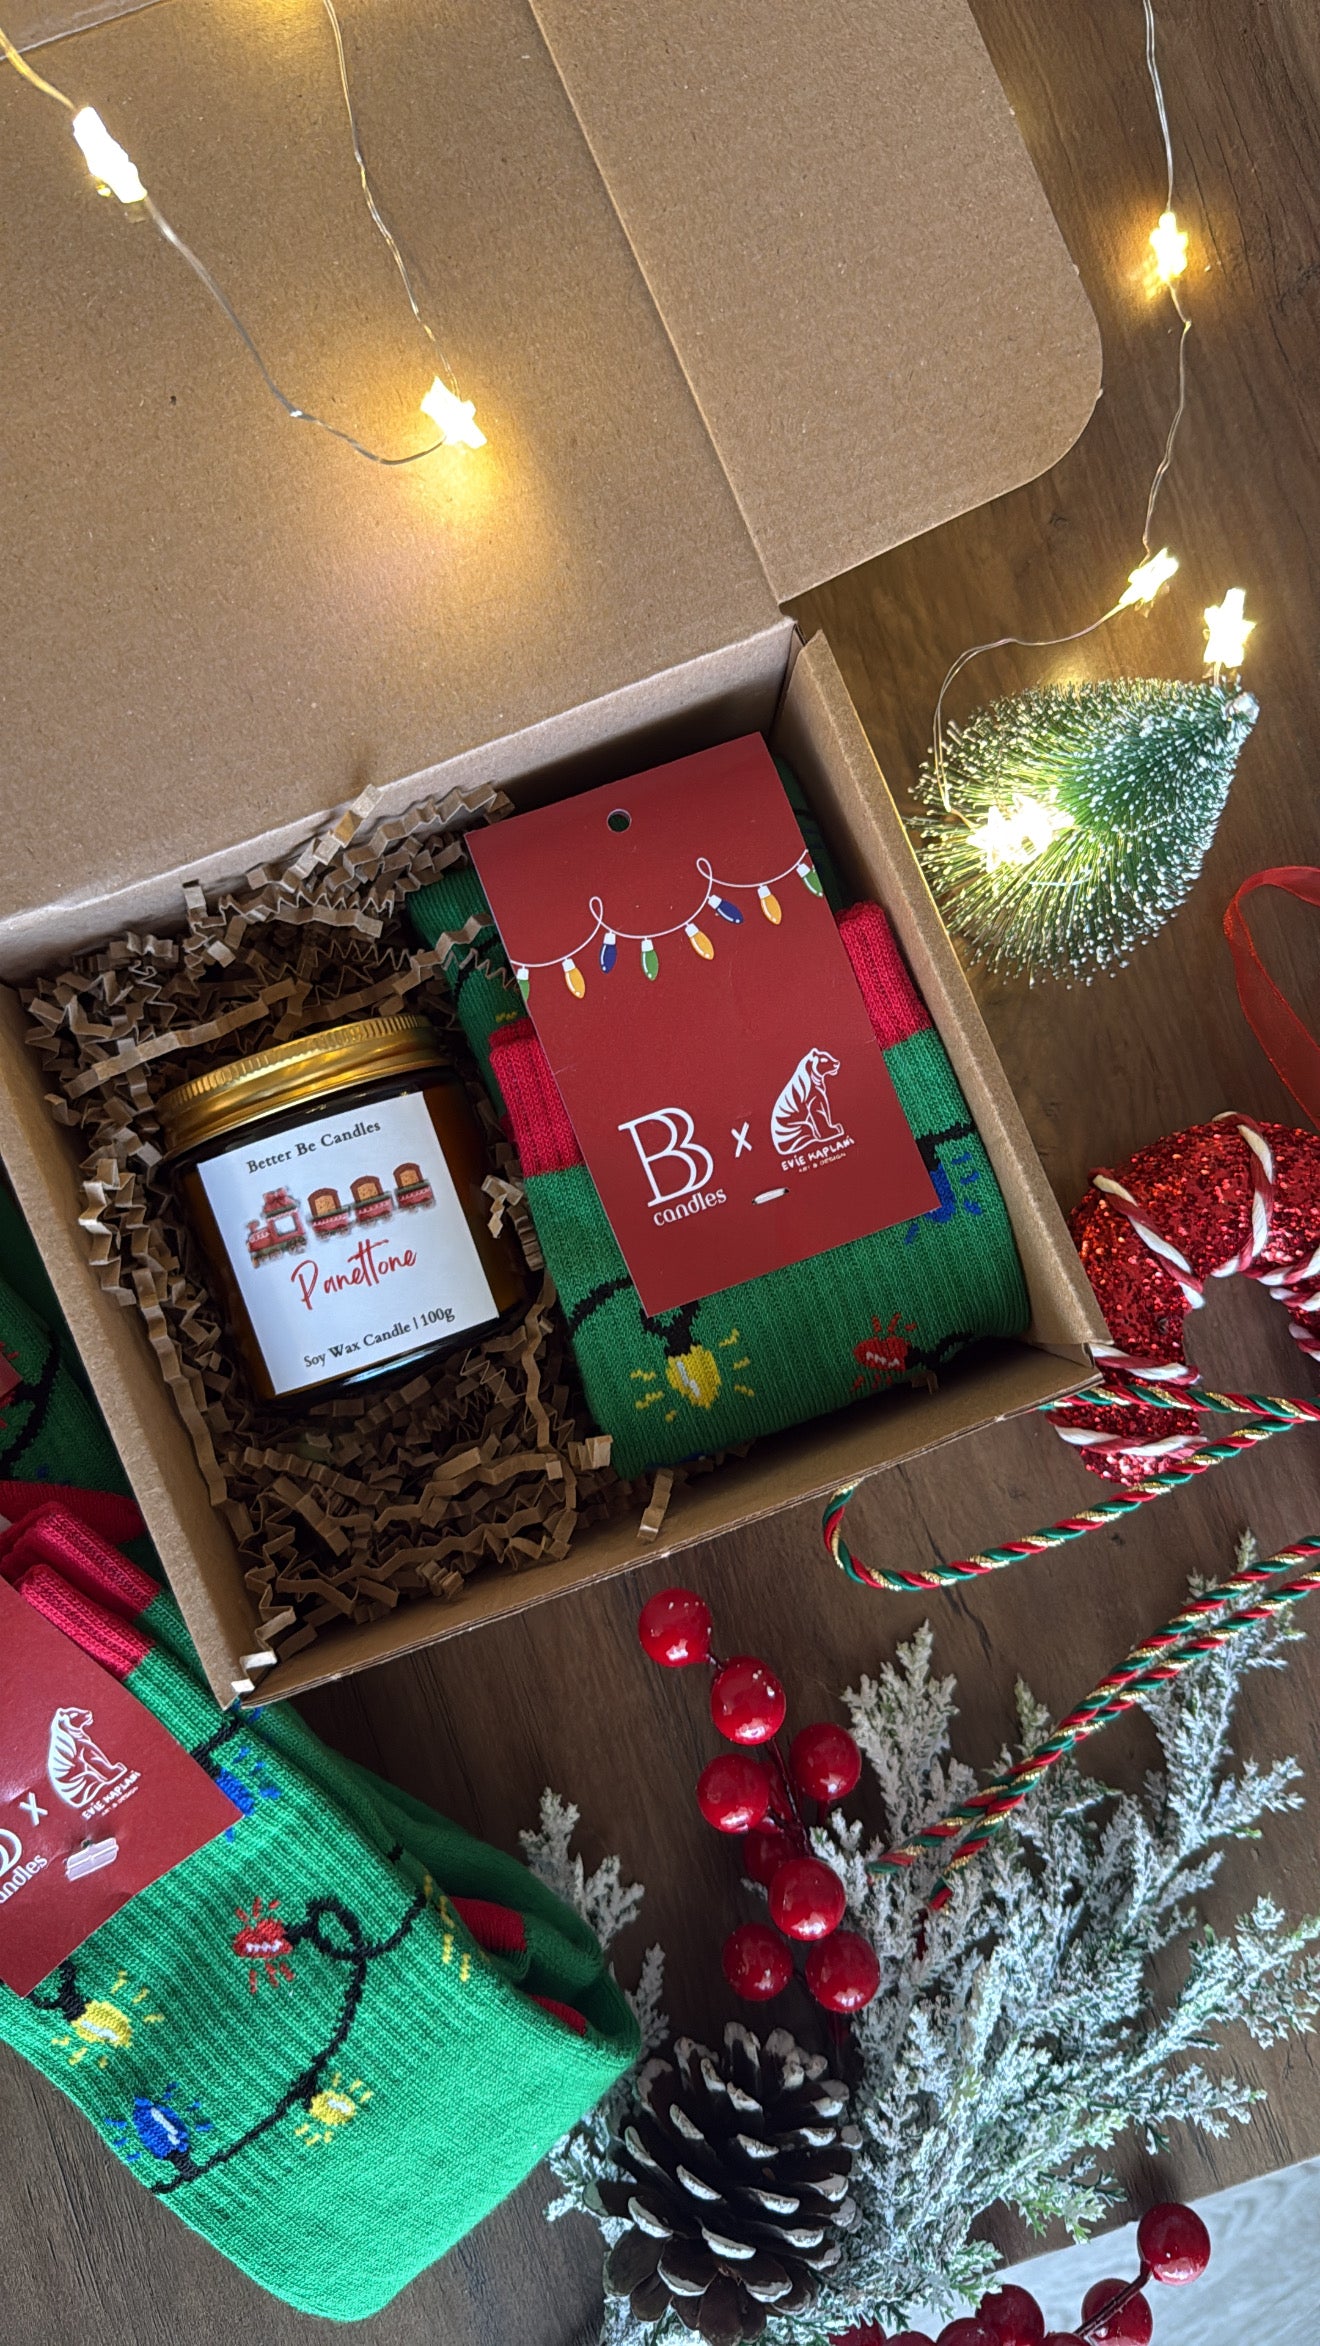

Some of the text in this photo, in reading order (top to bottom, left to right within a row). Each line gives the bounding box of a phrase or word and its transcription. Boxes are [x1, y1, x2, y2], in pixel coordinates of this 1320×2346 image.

[246, 1120, 382, 1174] Better Be Candles
[653, 1188, 727, 1227] candles
[290, 1238, 418, 1311] Panettone
[303, 1352, 327, 1368] Soy
[327, 1341, 361, 1359] Wax
[363, 1321, 411, 1348] Candle
[420, 1306, 456, 1328] 100g
